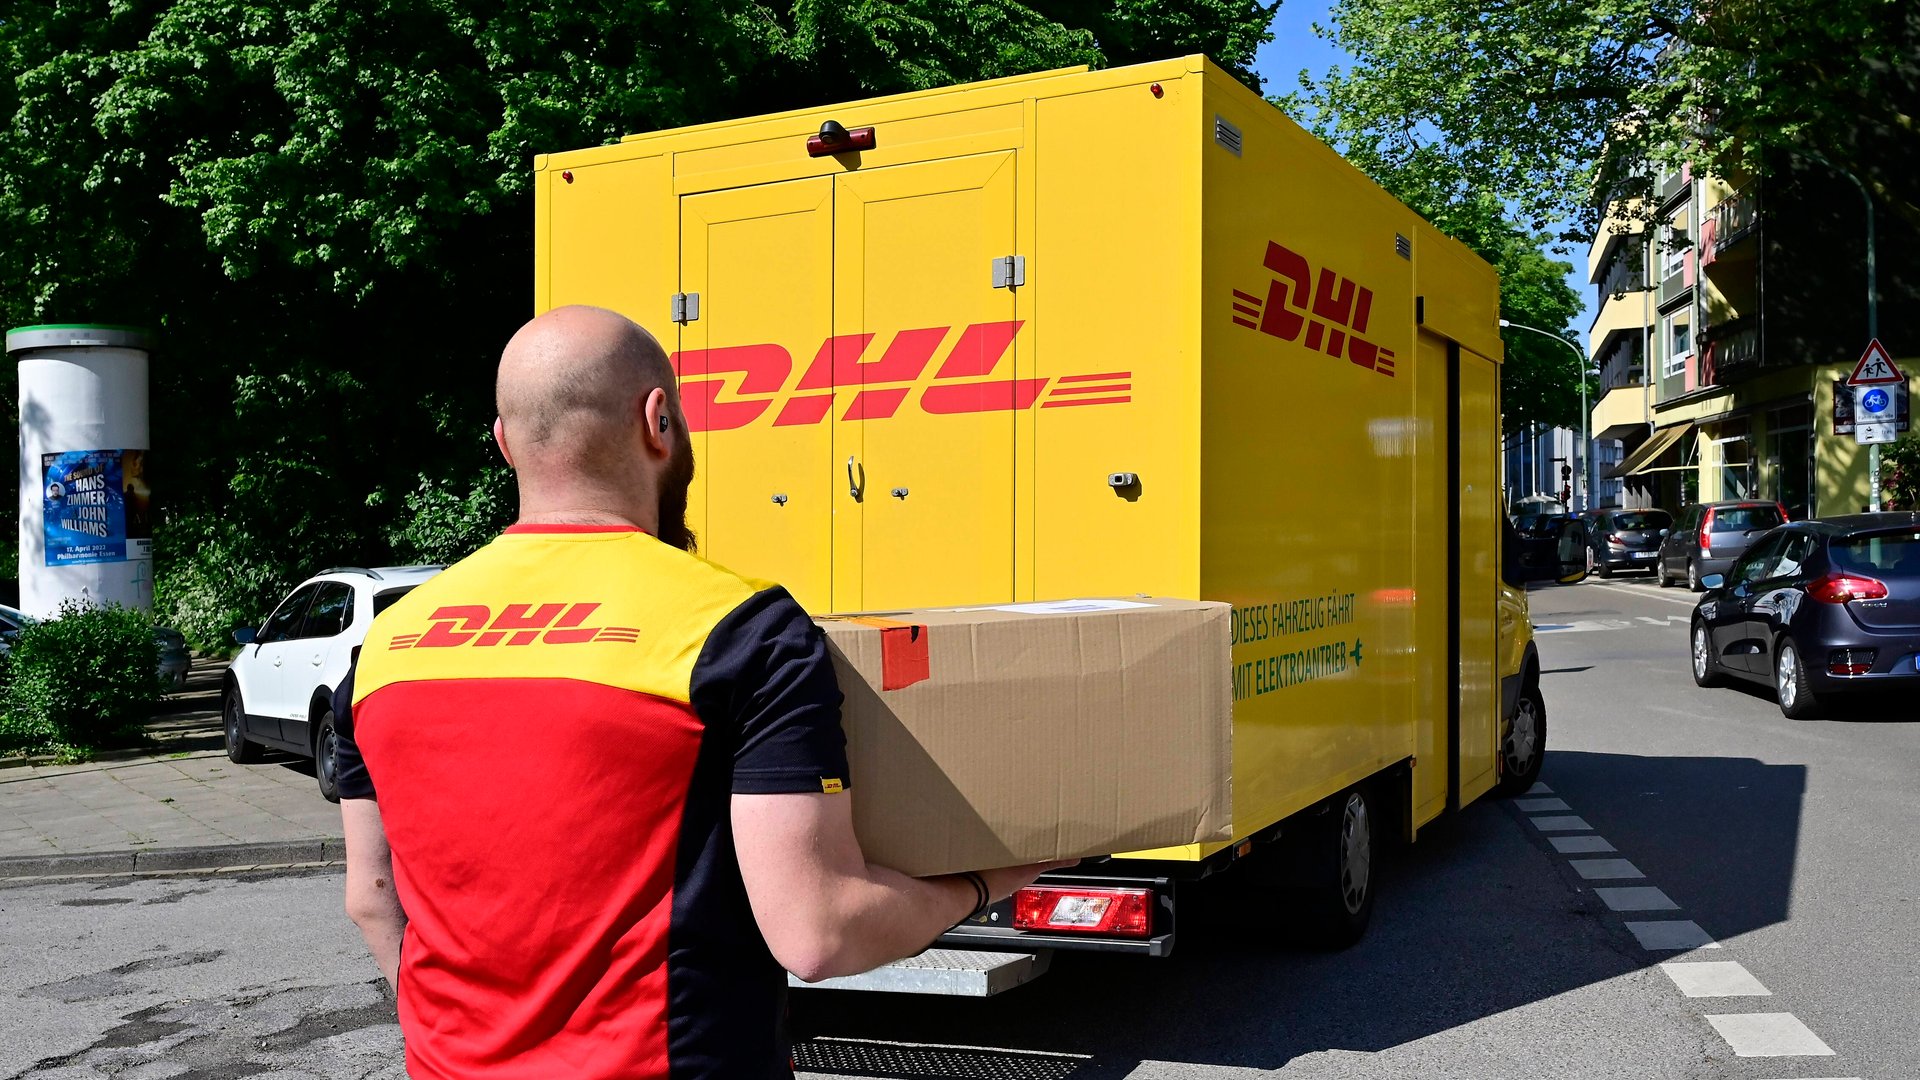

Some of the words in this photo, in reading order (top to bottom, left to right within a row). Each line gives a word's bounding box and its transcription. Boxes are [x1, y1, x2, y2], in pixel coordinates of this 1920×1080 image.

[1258, 239, 1379, 371] DHL
[670, 319, 1051, 433] DHL
[75, 474, 105, 492] HANS
[61, 518, 108, 538] WILLIAMS
[78, 506, 106, 521] JOHN
[57, 552, 98, 561] Philharmonie
[99, 550, 116, 558] Essen
[74, 545, 91, 553] April
[413, 602, 603, 648] DHL
[1231, 604, 1268, 645] DIESES
[1272, 597, 1324, 638] FAHRZEUG
[1327, 588, 1355, 627] FÄHRT
[1232, 662, 1253, 701] MIT
